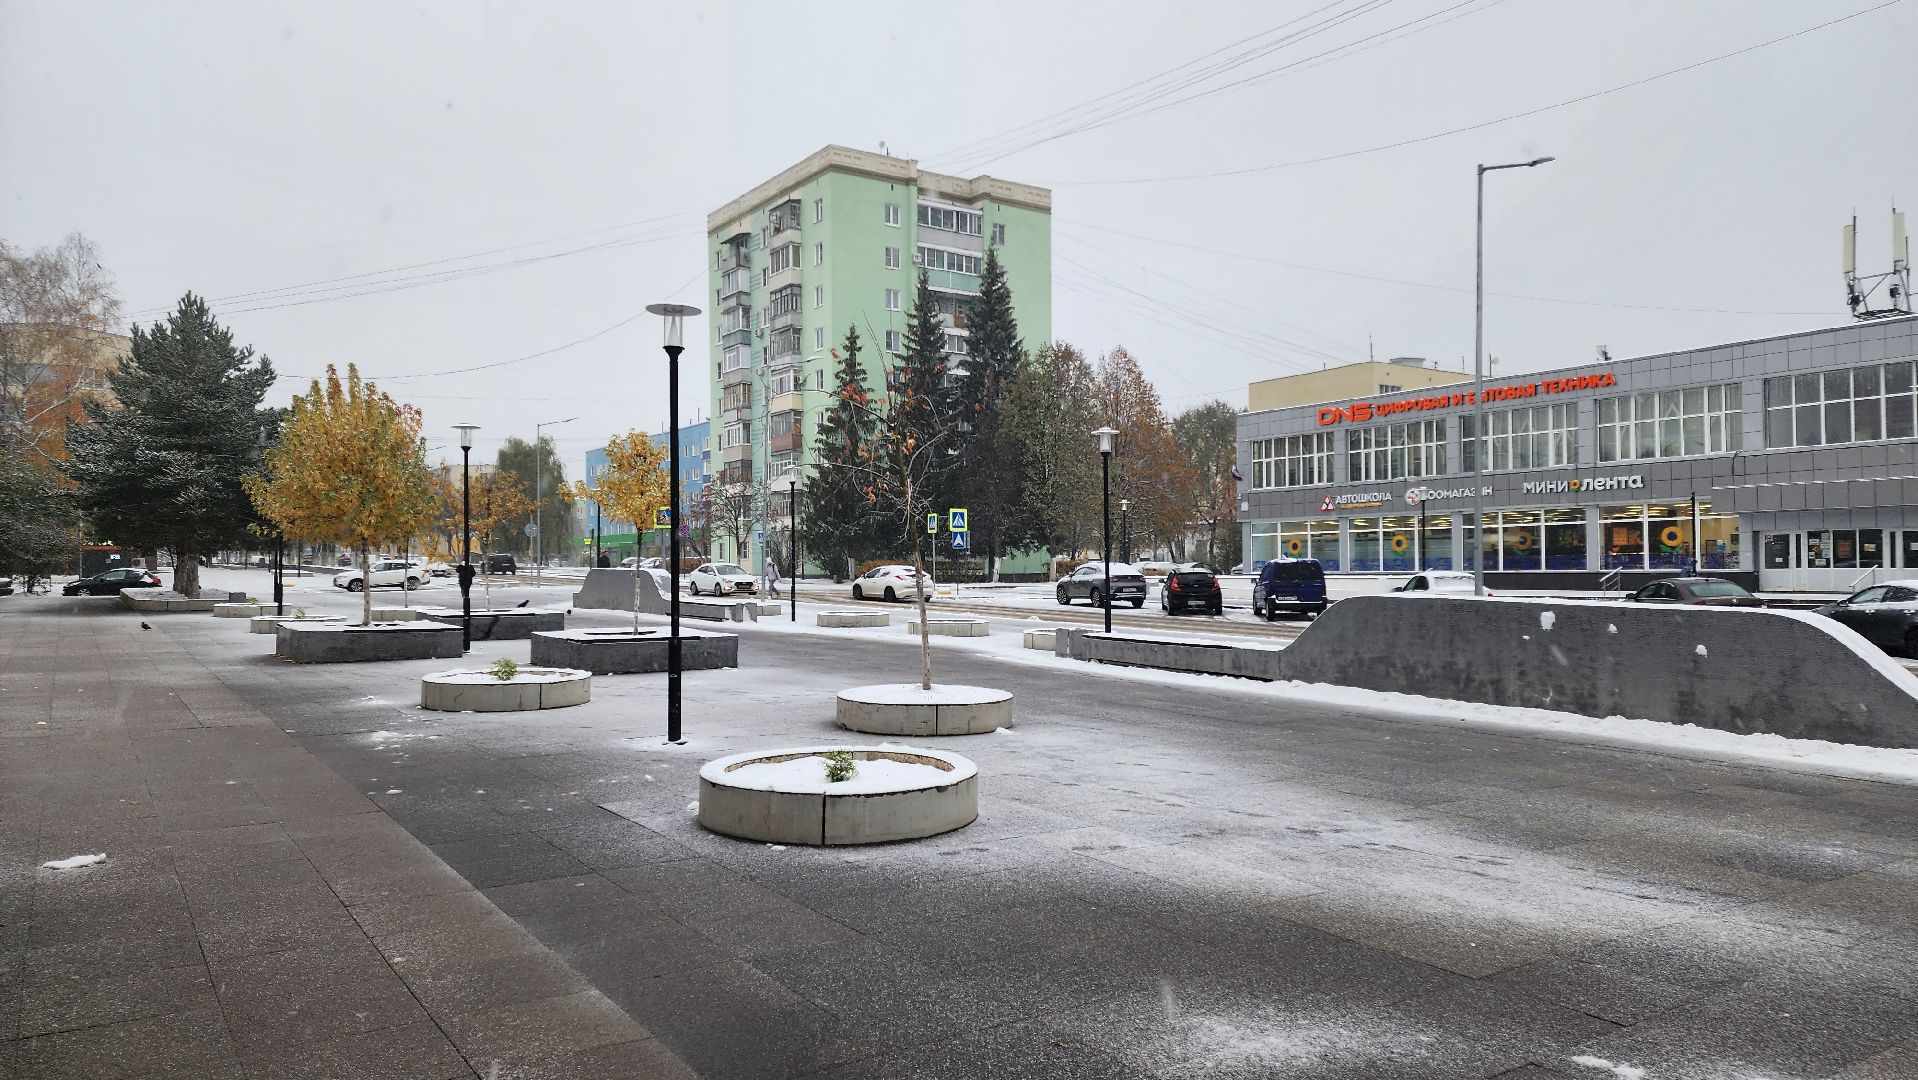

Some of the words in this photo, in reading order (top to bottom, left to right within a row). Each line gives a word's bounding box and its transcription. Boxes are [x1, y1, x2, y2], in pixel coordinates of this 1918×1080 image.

[1318, 402, 1373, 426] DNS
[1375, 393, 1450, 417] ЦИФРОВАЯ
[1452, 392, 1464, 406] И
[1541, 372, 1616, 395] ТЕХНИКА
[1336, 491, 1392, 505] АВТОШКОЛА
[1421, 486, 1493, 501] ООМАГАЗН
